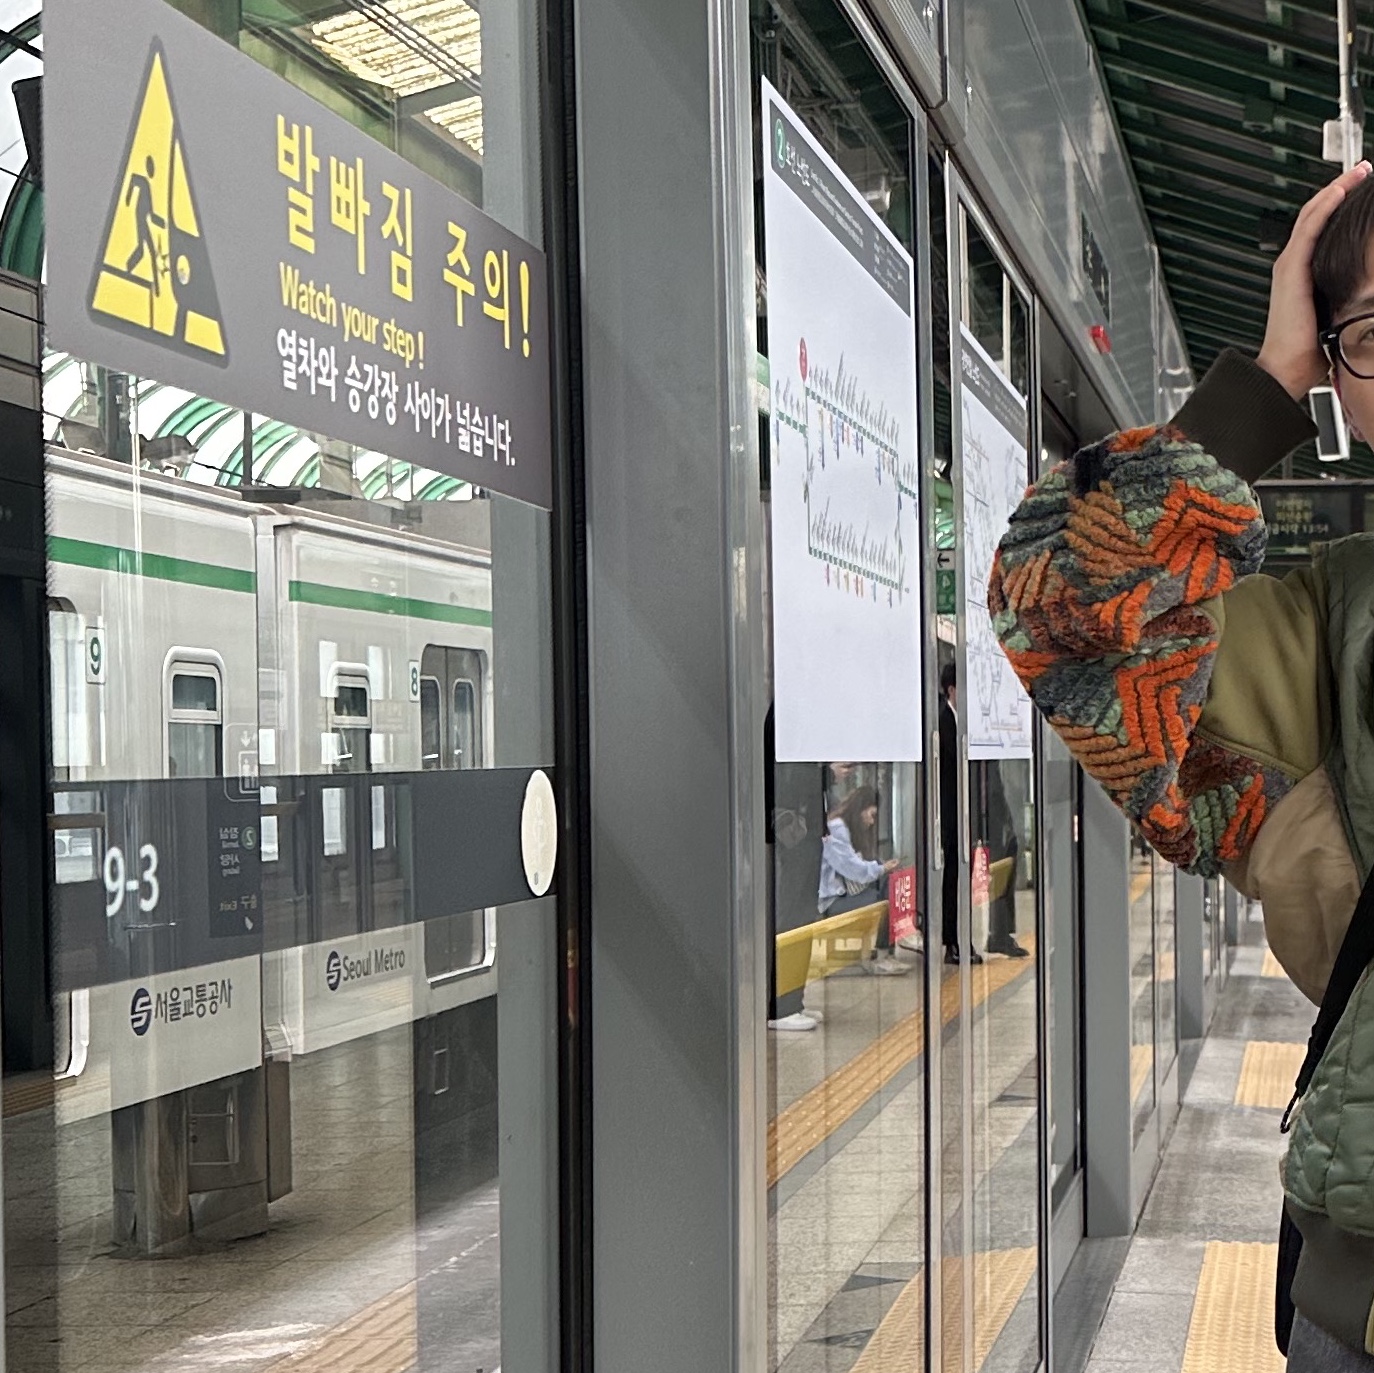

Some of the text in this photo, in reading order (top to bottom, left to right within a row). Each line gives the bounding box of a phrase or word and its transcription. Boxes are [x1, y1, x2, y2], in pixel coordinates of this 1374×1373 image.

[277, 113, 530, 358] 발빠짐 주의!
[279, 261, 338, 328] Watch
[341, 302, 380, 342] your
[276, 327, 516, 467] 열차와 승강장 사이가 넓습니다.
[90, 636, 101, 676] 9
[410, 666, 419, 697] 8
[103, 843, 160, 917] 9-3
[342, 948, 406, 982] Seoul Metro
[154, 977, 234, 1024] 서울교통공사
